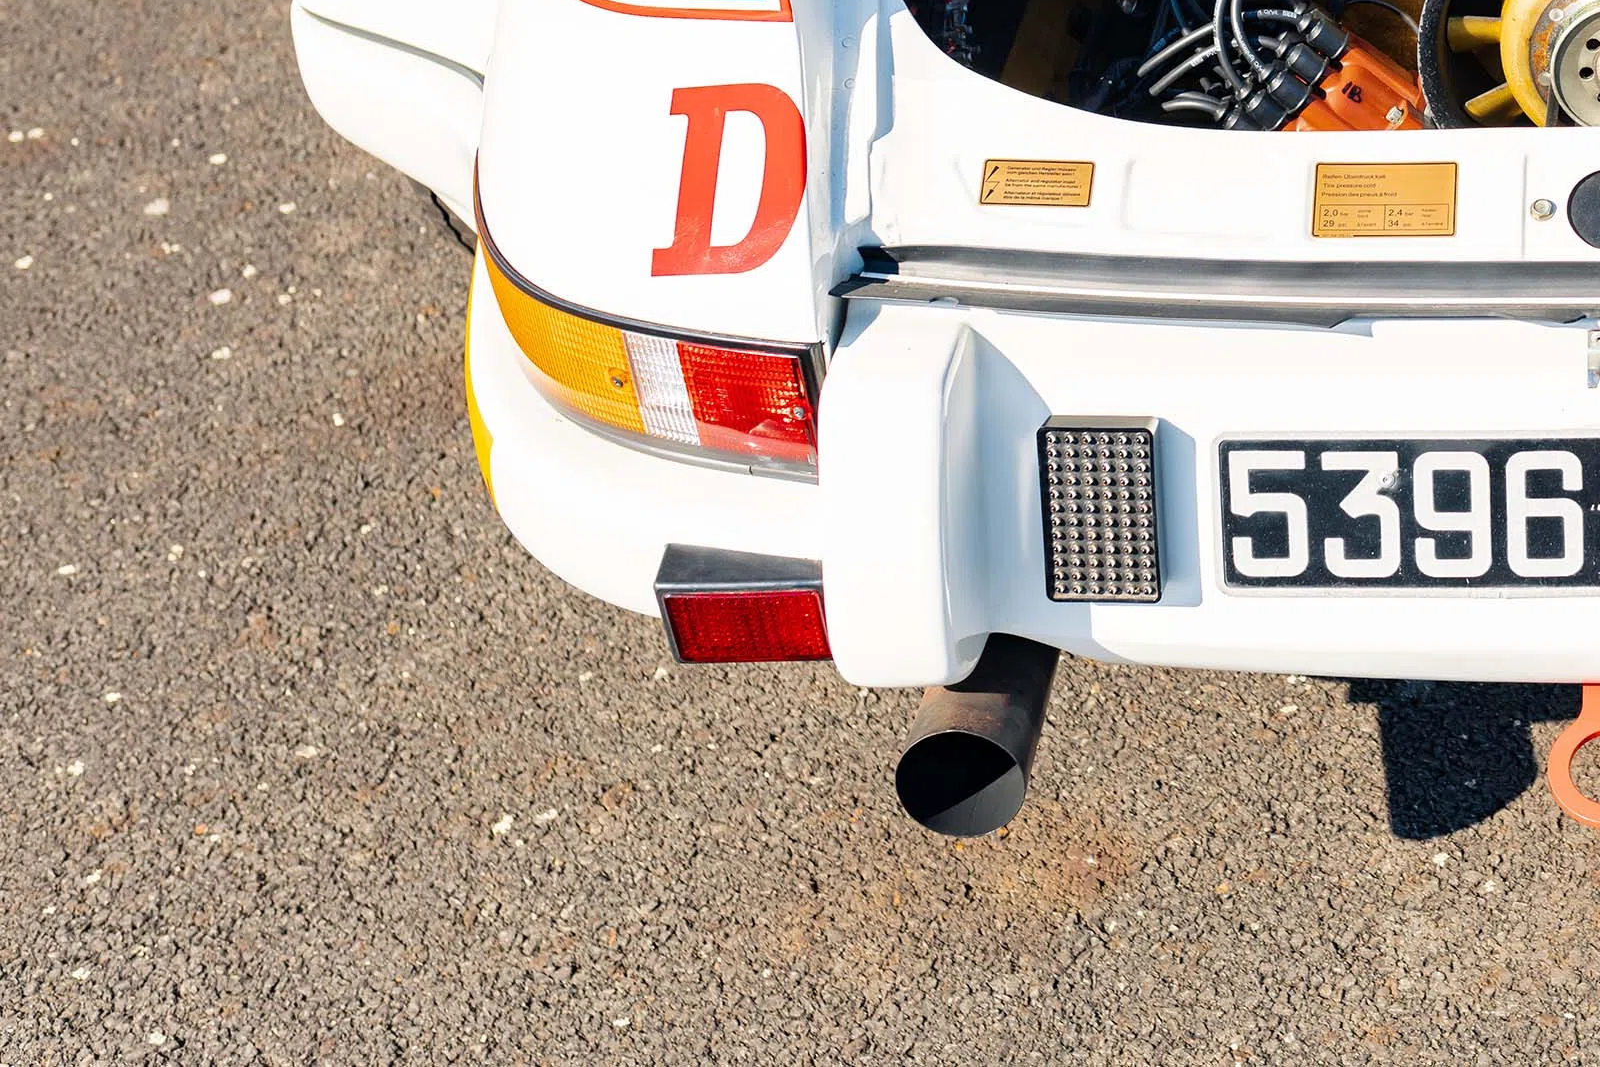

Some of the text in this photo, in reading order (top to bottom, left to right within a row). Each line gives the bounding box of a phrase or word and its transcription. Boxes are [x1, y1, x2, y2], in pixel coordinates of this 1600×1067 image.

[651, 83, 808, 277] D
[1323, 220, 1335, 228] 29
[1387, 219, 1399, 227] 34
[1230, 447, 1586, 580] 5396
